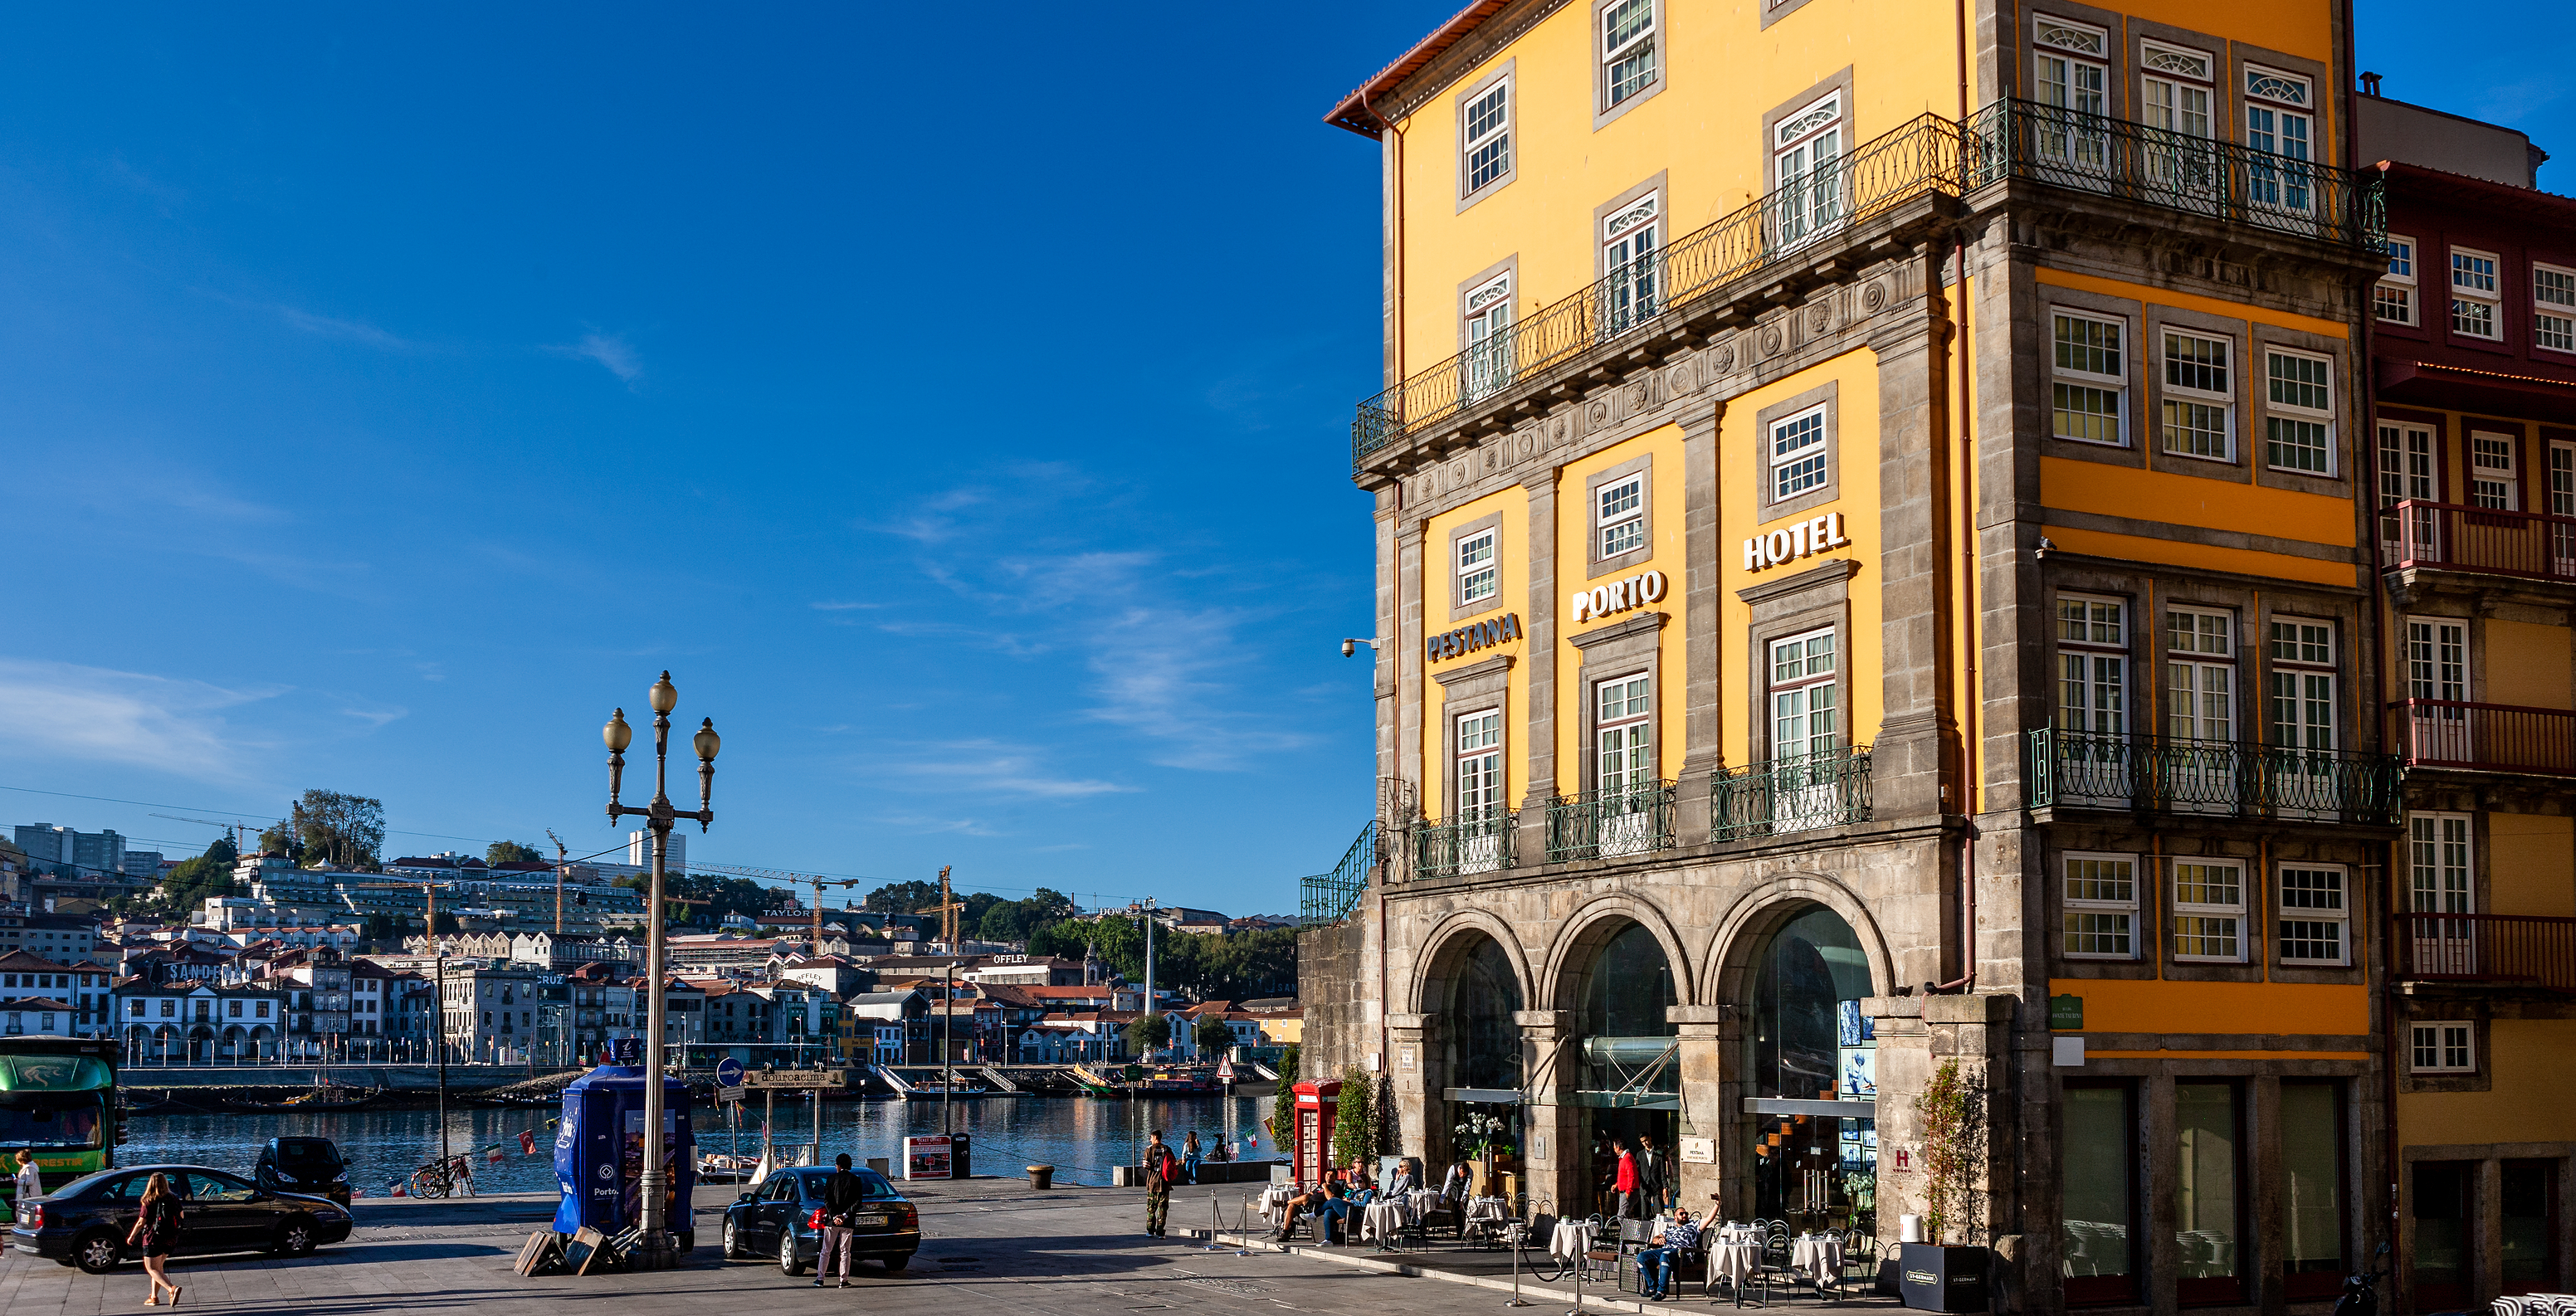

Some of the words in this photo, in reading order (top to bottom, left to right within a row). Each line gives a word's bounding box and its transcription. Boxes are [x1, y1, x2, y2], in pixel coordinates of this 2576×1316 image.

[1744, 512, 1846, 572] HOTEL
[1573, 570, 1665, 622] PORTO
[1427, 612, 1520, 662] PESTANA
[1100, 907, 1132, 916] DOW'S
[993, 954, 1029, 963] OFFLEY
[170, 964, 252, 980] SANDEMAN
[537, 975, 564, 985] CRUZ
[1278, 983, 1297, 992] SAN
[761, 1073, 827, 1082] douroacima
[33, 1158, 83, 1167] RRESTIR
[1896, 1149, 1909, 1167] H
[594, 1187, 619, 1197] Porto.
[1910, 1274, 1934, 1282] ST-GERMAIN
